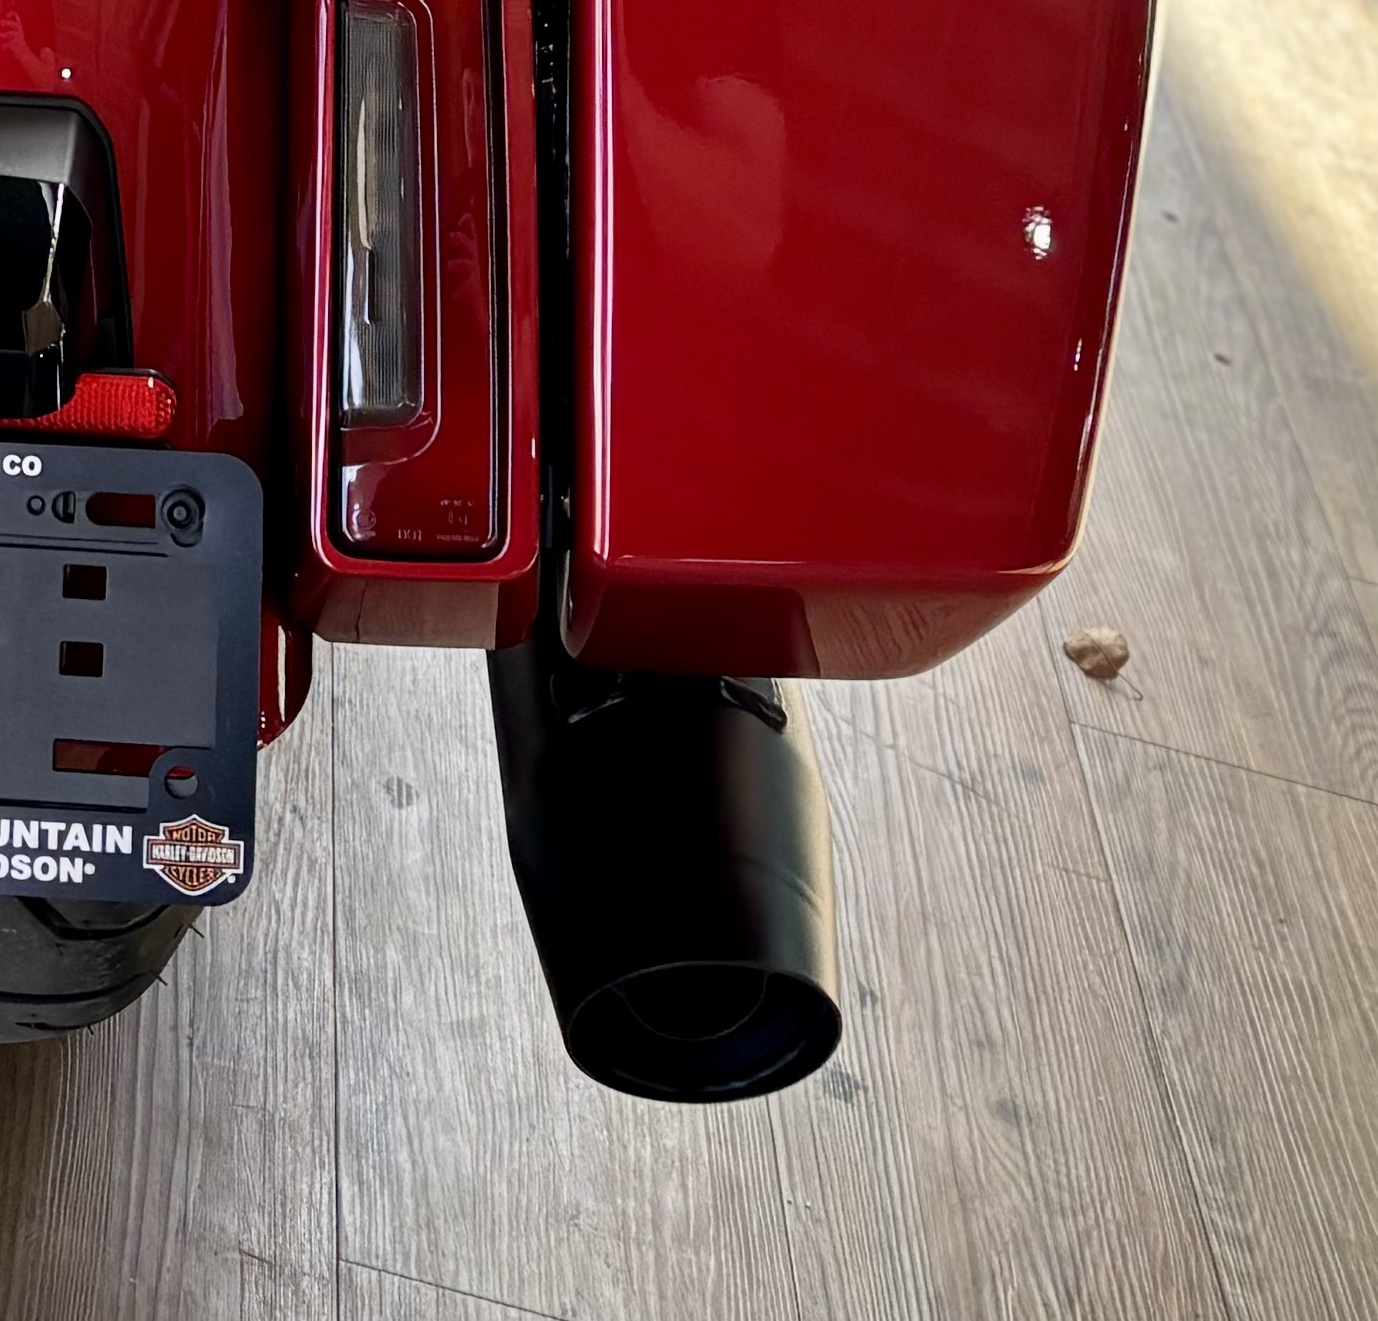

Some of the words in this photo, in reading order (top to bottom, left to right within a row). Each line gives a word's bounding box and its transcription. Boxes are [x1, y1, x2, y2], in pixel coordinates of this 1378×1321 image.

[2, 454, 43, 477] CO
[172, 825, 216, 842] MOTOR
[171, 866, 216, 886] CYCLES
